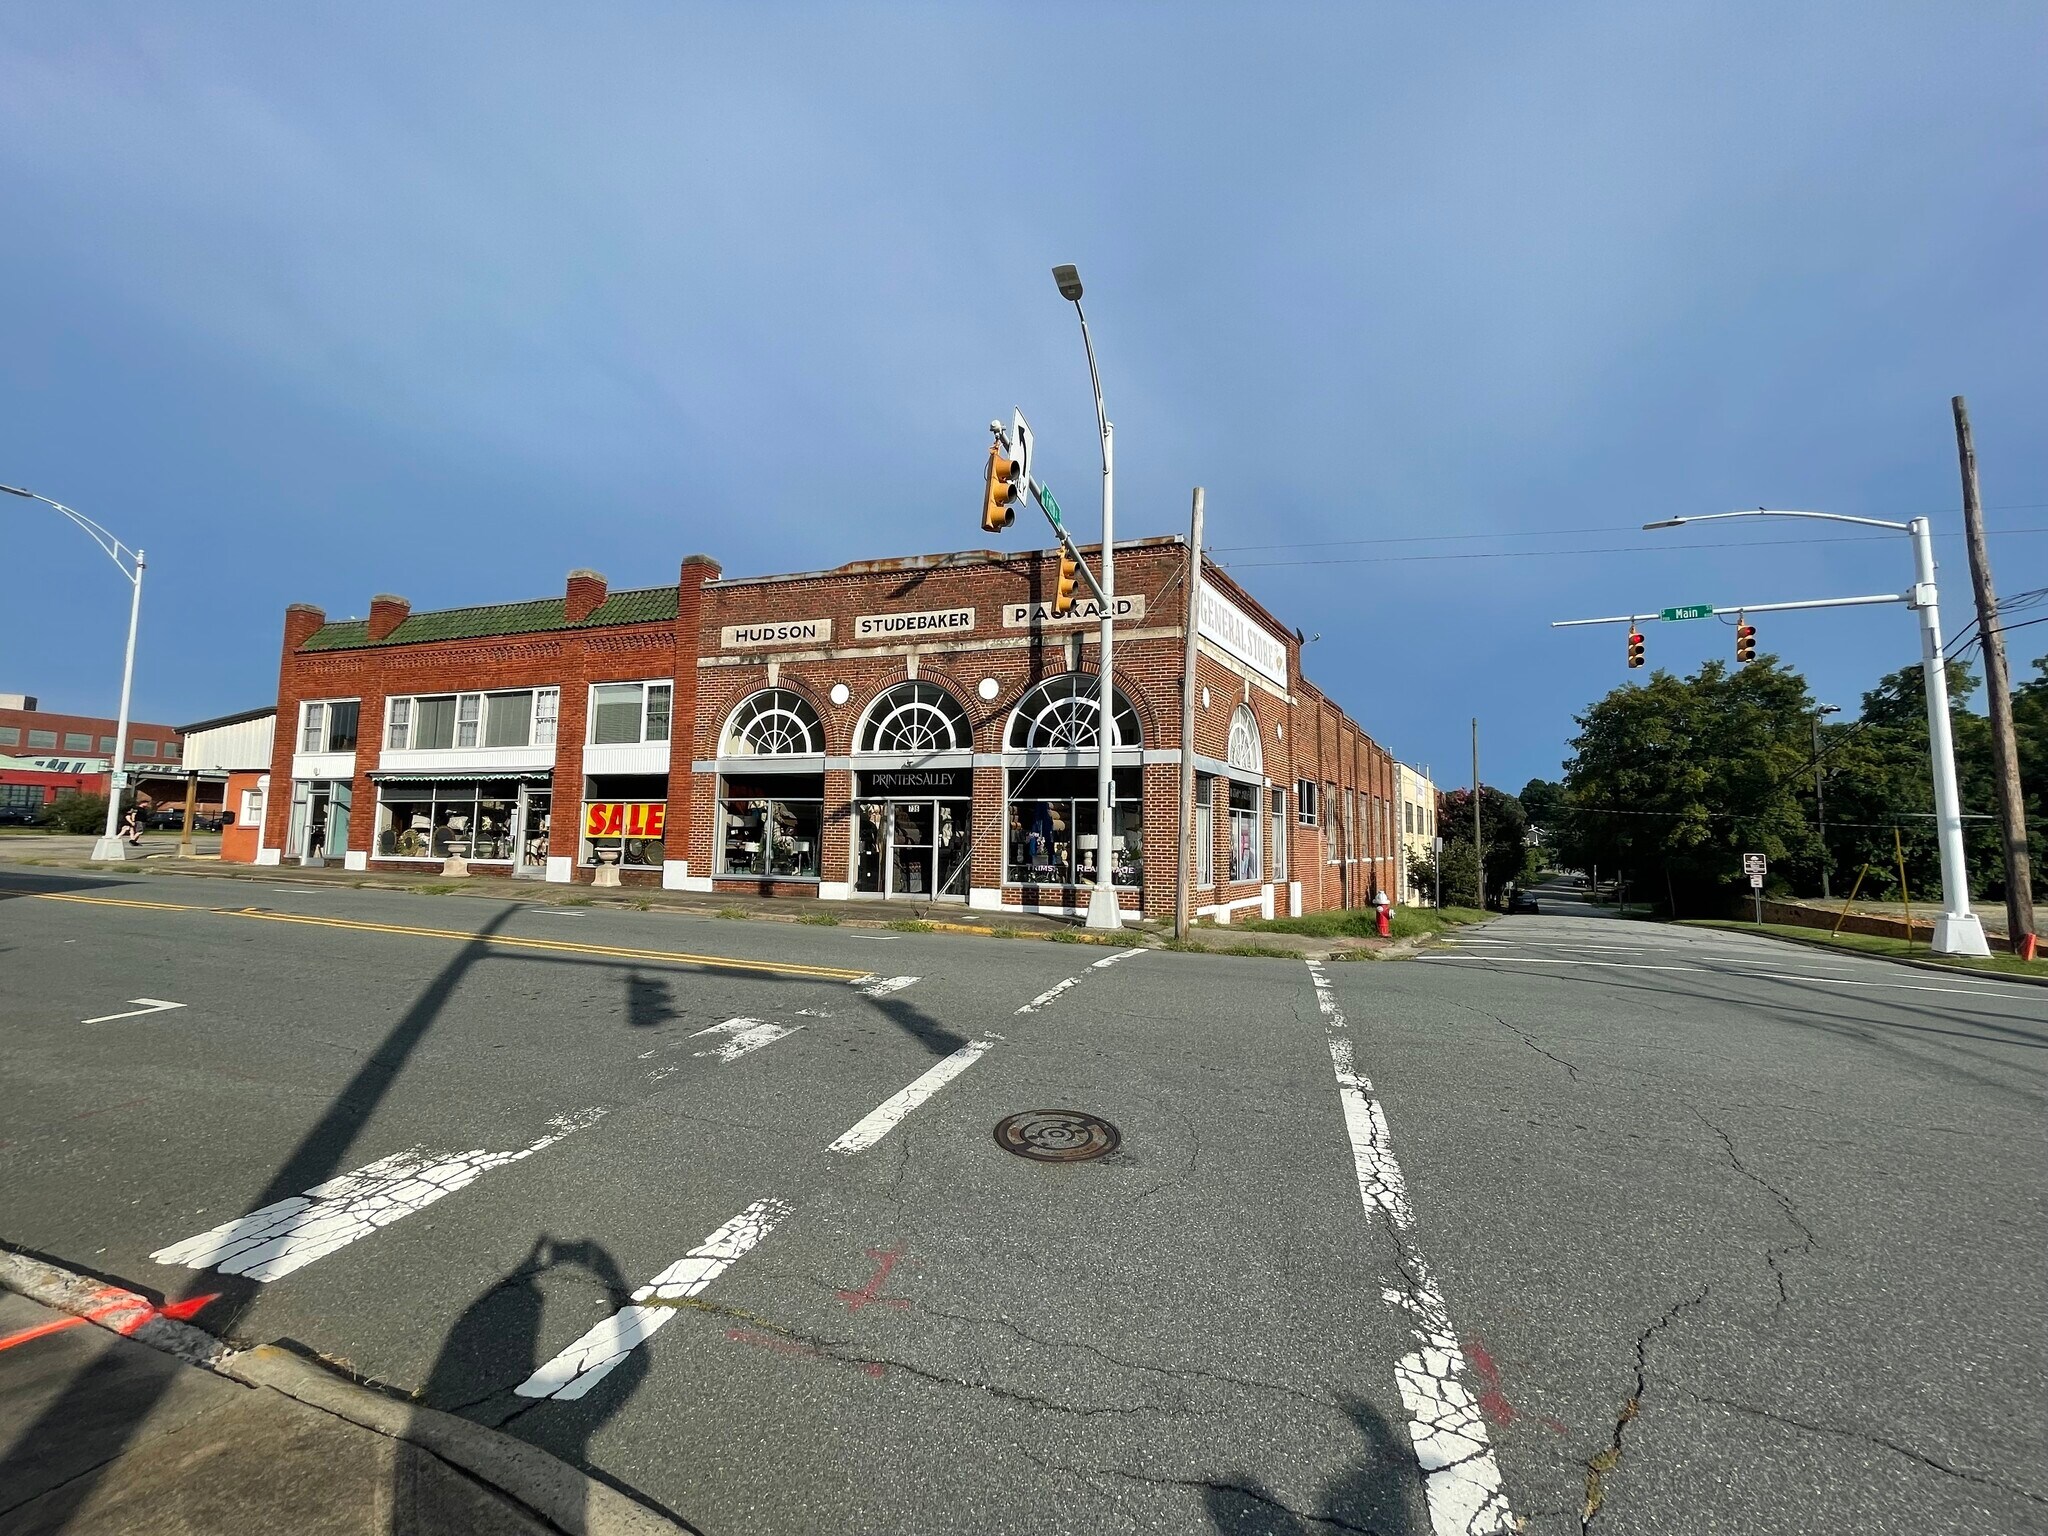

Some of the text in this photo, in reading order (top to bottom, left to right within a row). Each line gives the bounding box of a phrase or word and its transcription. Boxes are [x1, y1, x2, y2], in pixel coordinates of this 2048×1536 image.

[1015, 600, 1132, 622] PAKAD
[1675, 607, 1698, 619] Main
[735, 624, 816, 642] HUDSON
[861, 612, 969, 633] STUDEBAKER
[1200, 590, 1274, 672] GENERAL STORE
[588, 803, 664, 835] SALE
